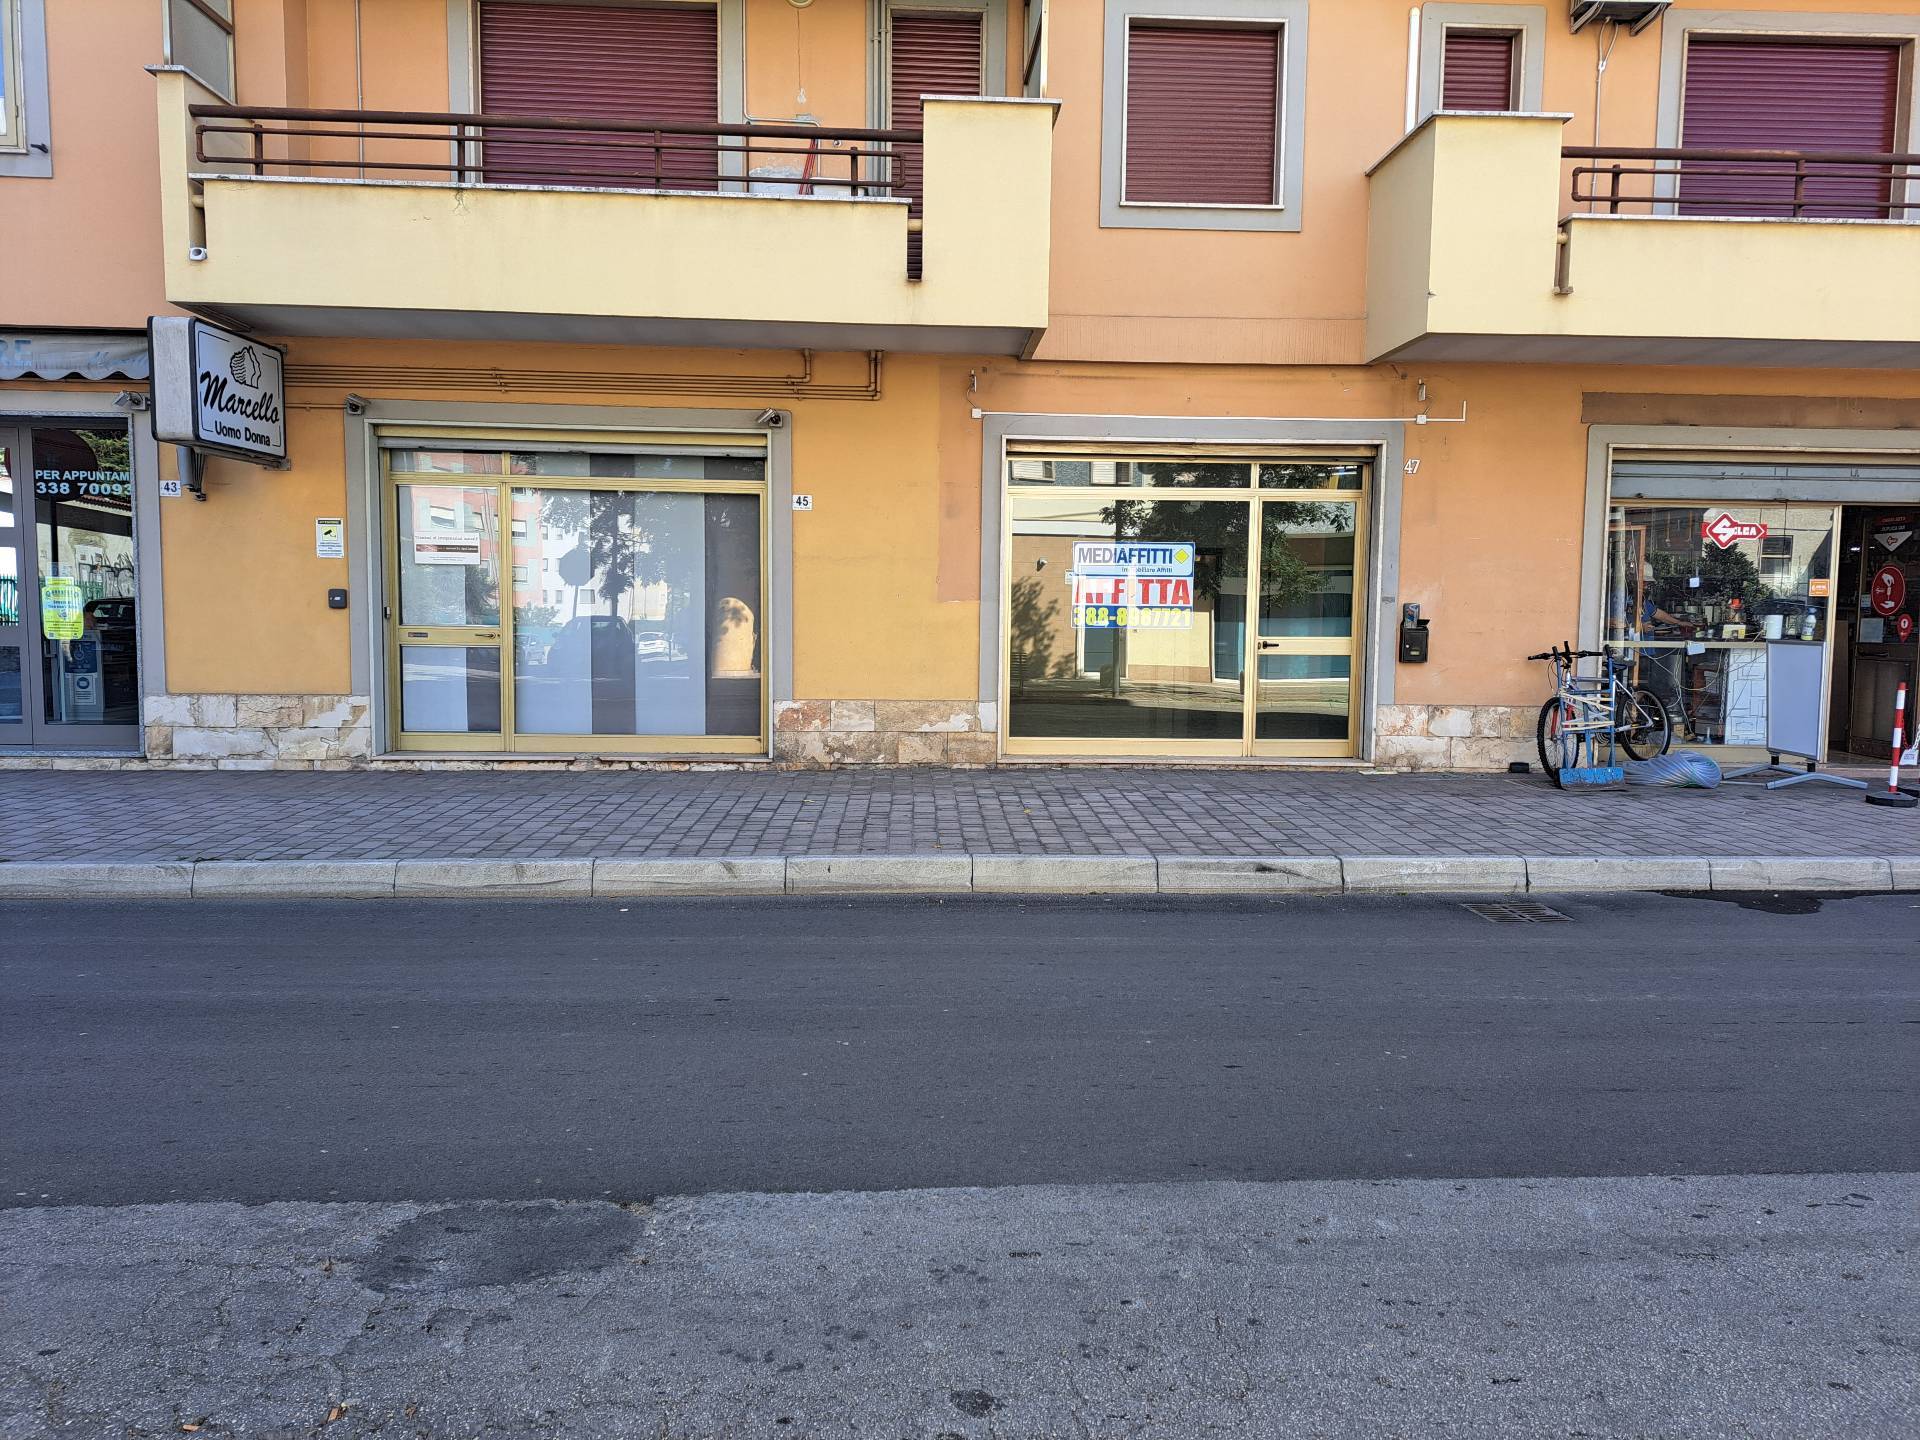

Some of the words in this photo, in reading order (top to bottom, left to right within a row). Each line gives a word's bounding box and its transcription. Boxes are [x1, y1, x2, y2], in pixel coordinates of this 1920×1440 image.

[200, 371, 280, 424] Marcello
[215, 420, 241, 440] Uomo
[244, 427, 270, 446] Donna
[1404, 459, 1421, 474] 47
[35, 470, 60, 480] PER
[36, 482, 70, 495] 338
[163, 481, 177, 492] 43
[796, 495, 809, 506] 45
[1079, 547, 1173, 564] MEDIAFFITTI
